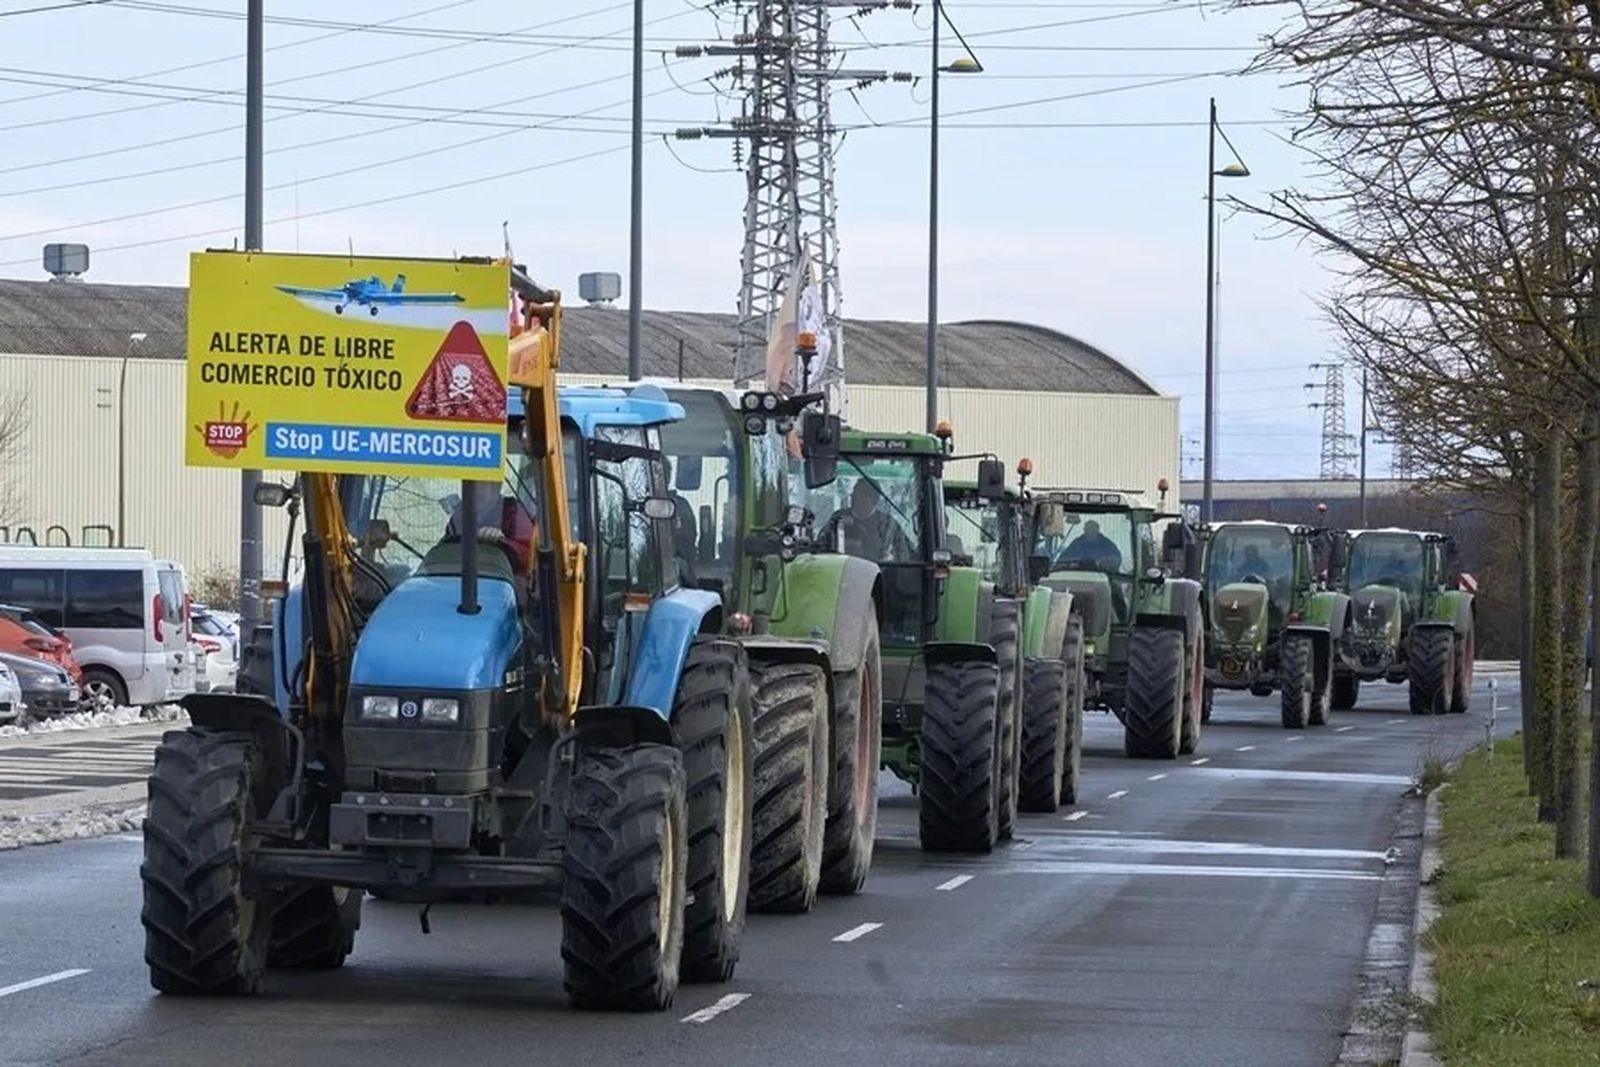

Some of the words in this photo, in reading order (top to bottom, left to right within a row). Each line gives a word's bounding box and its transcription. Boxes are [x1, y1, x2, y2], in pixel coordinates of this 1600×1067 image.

[210, 332, 290, 354] ALERTA
[299, 335, 326, 356] DE
[335, 337, 395, 359] LIBRE
[201, 362, 315, 387] COMERCIO
[324, 363, 402, 391] TÓXICO
[209, 425, 243, 438] STOP
[275, 428, 323, 454] Stop
[332, 430, 491, 458] UE-MERCOSUR
